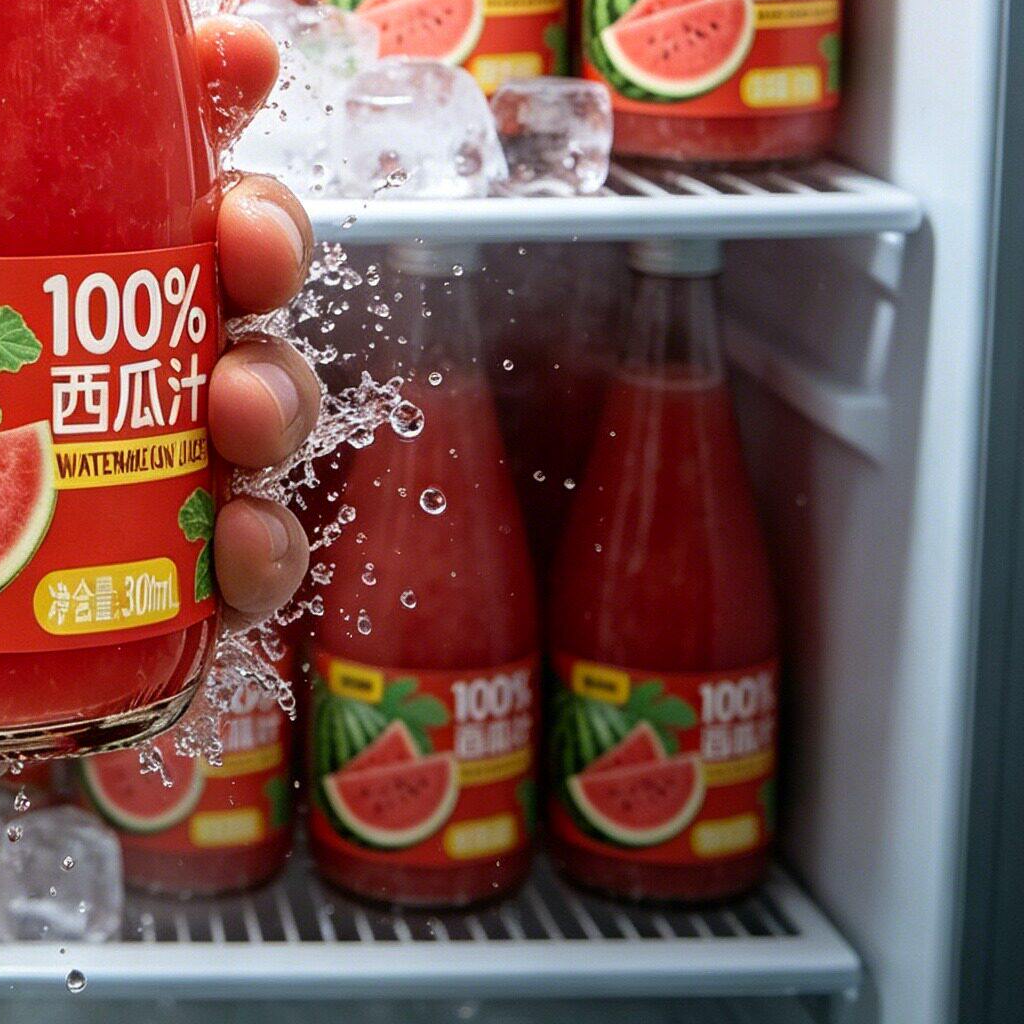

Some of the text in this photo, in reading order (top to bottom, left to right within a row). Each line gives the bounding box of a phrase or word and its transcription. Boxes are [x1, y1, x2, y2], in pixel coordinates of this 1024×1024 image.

[42, 263, 207, 357] 100%
[50, 352, 207, 435] 西瓜汁
